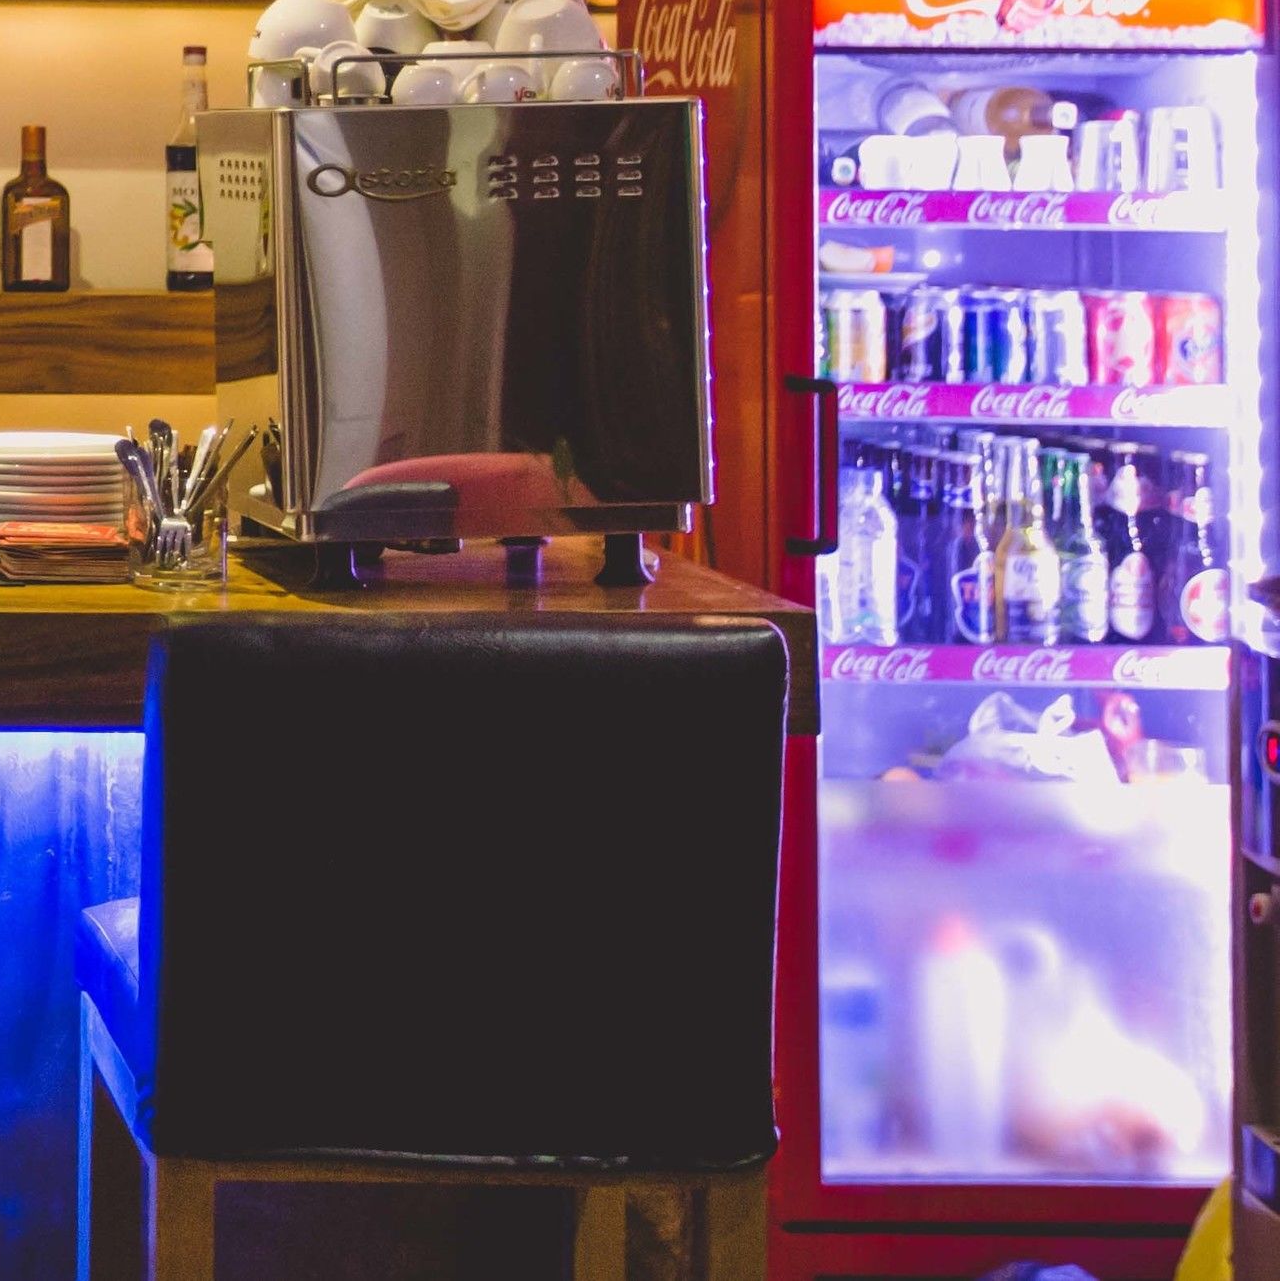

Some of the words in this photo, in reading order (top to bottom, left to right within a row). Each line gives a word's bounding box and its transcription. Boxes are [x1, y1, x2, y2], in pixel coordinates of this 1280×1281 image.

[827, 191, 928, 224] Coca-Cola
[967, 192, 1069, 225] Coca-Cola
[970, 385, 1072, 418] Coca-Cola
[831, 648, 934, 684] Coca-Cola
[972, 648, 1075, 682] Coca-Cola
